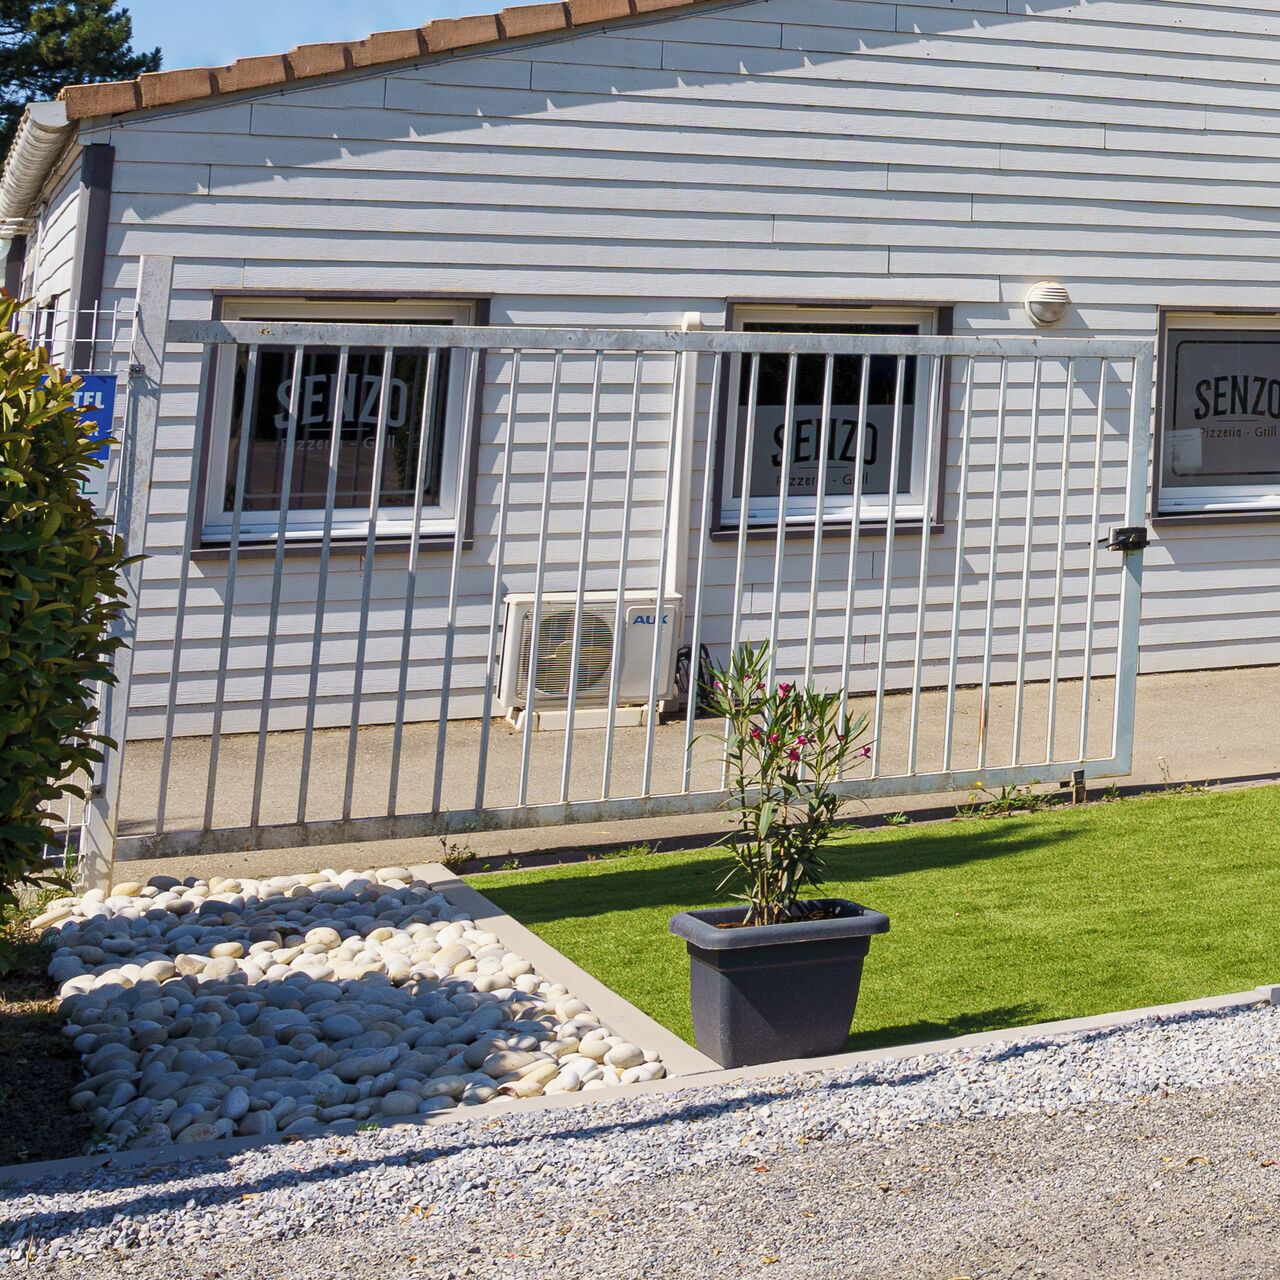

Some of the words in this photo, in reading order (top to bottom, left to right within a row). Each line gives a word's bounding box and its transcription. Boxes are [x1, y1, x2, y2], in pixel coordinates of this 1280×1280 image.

[273, 373, 408, 430] SENZO
[770, 418, 878, 468] SENZO
[1255, 425, 1277, 438] Grill
